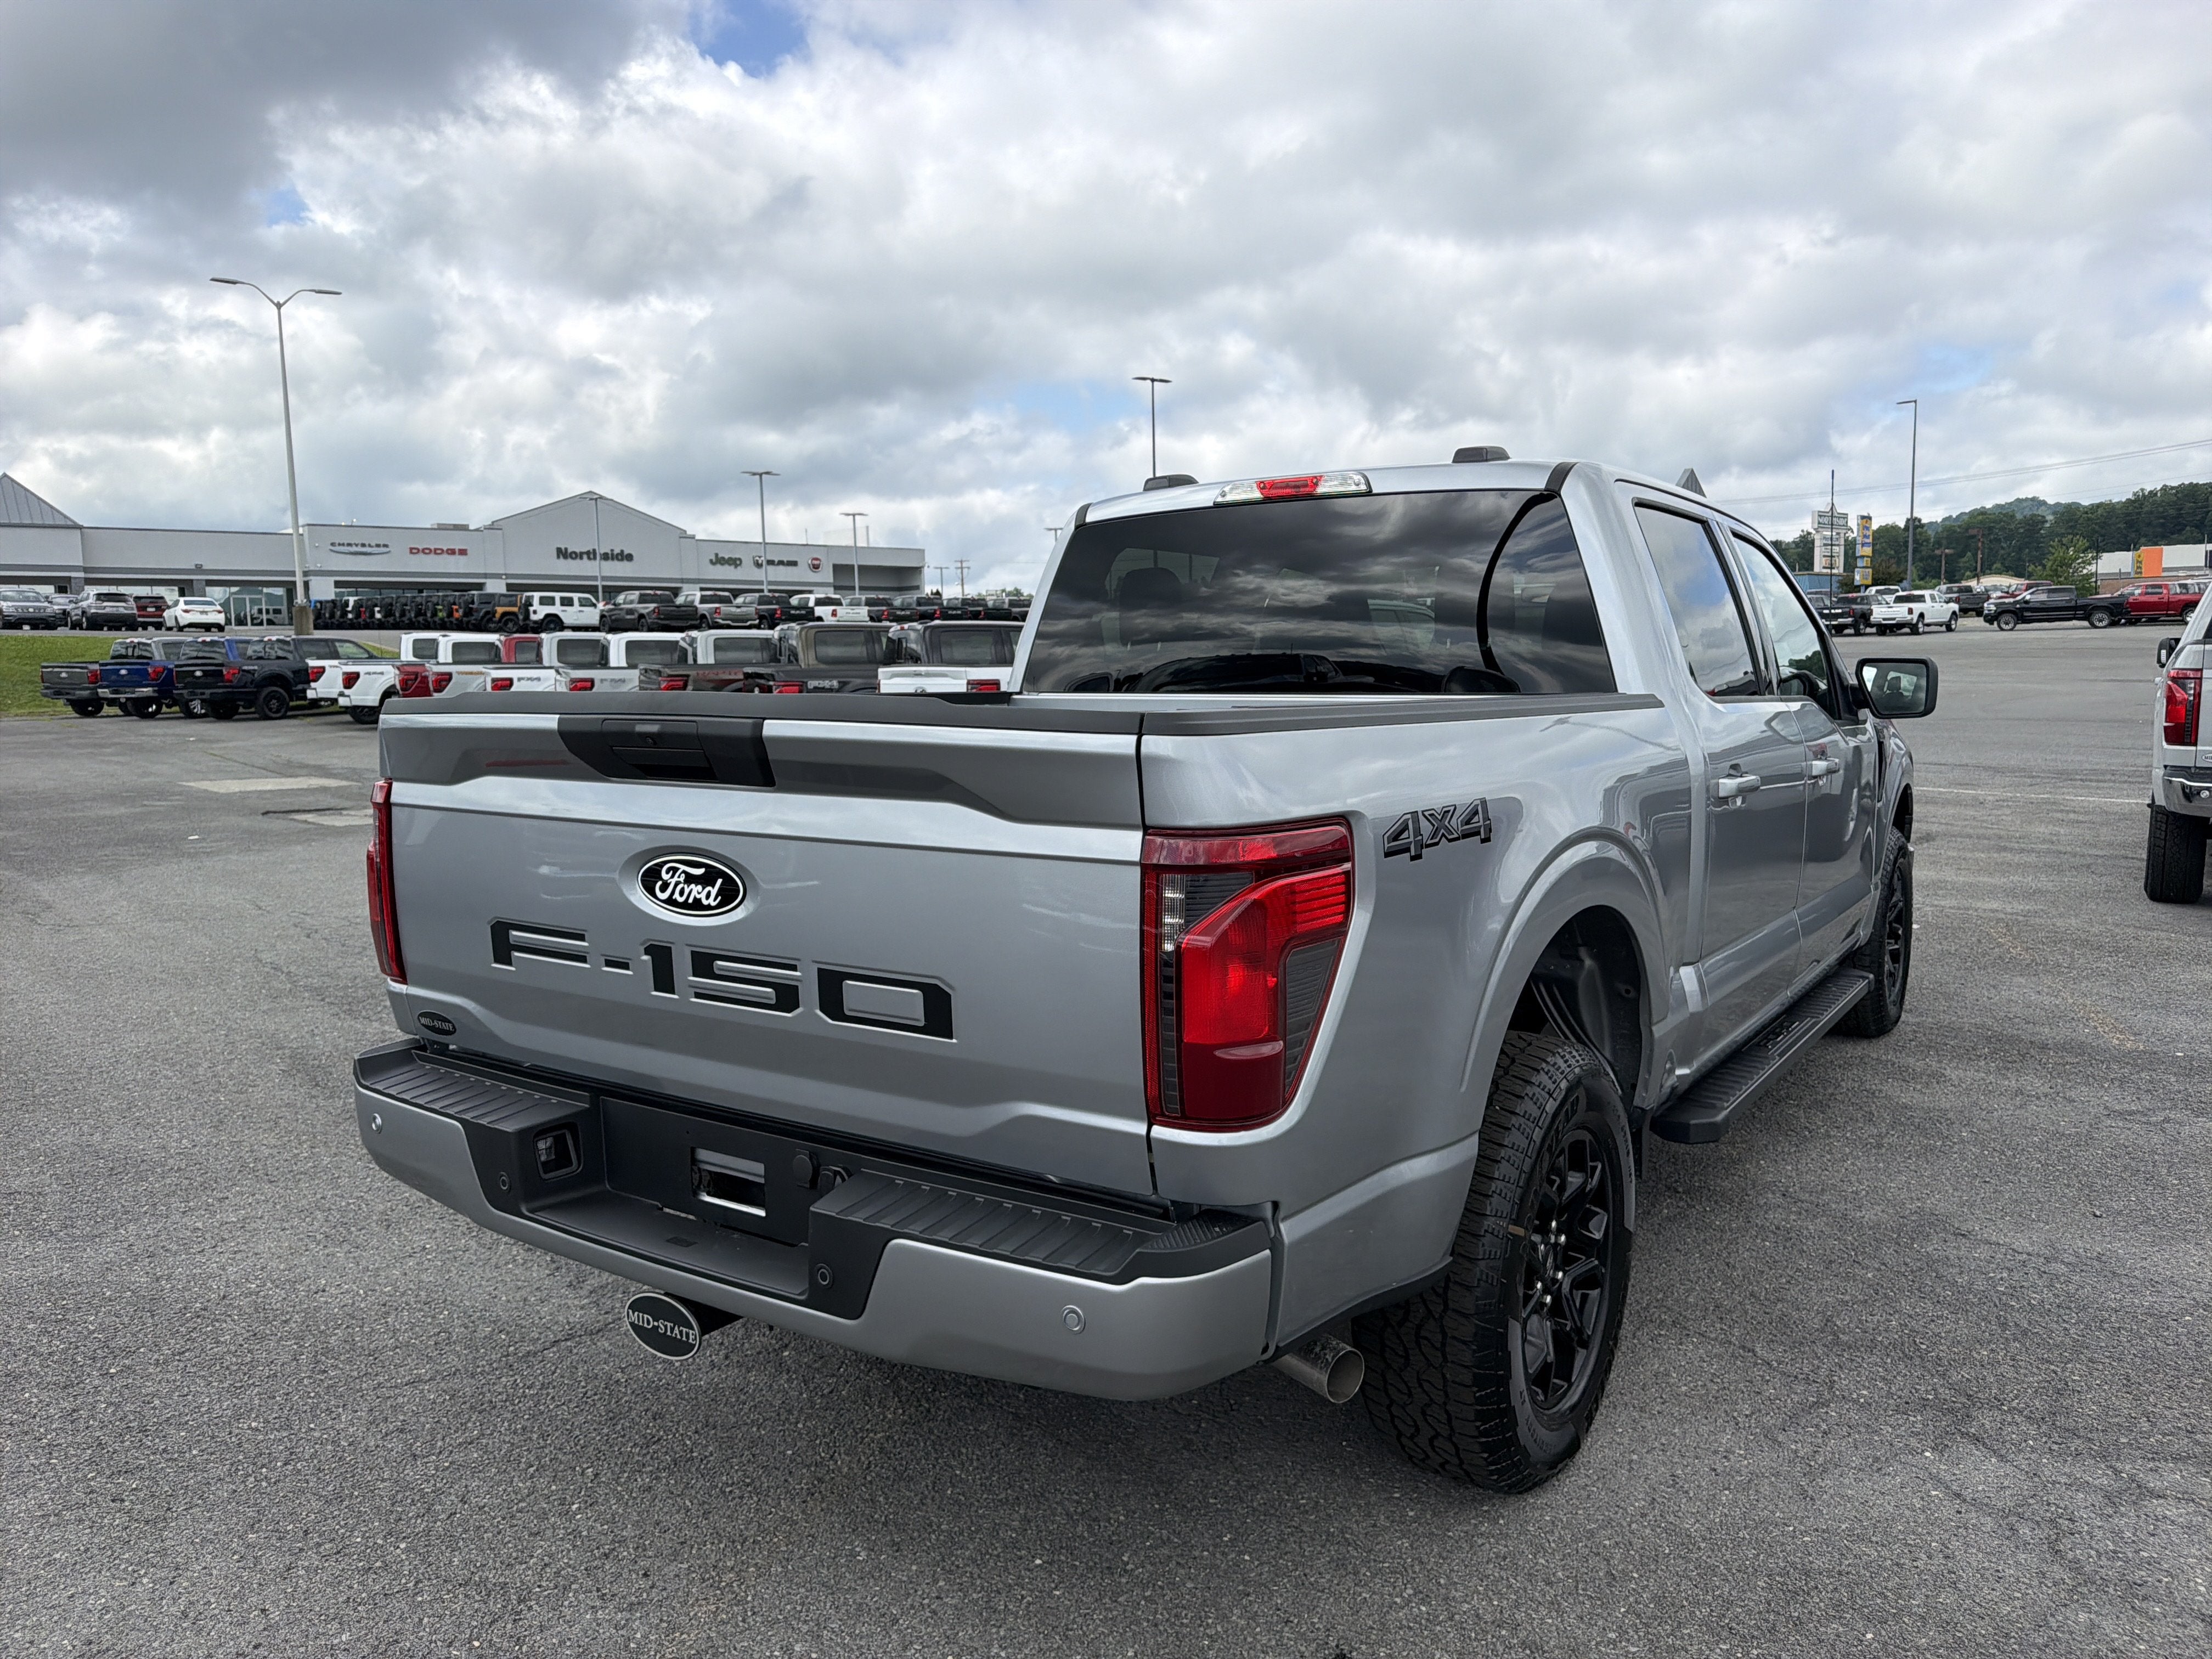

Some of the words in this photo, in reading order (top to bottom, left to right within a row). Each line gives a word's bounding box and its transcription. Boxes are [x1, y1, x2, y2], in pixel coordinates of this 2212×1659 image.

[409, 546, 468, 556] DODGE
[556, 546, 634, 562] Northside
[709, 552, 742, 568] Jeep
[766, 558, 798, 567] RAM
[654, 861, 724, 906] Ford
[1287, 963, 1322, 976] FORD
[488, 917, 957, 1042] F-150
[419, 1016, 454, 1031] MID-STATE
[628, 1309, 696, 1344] MID-STATE
